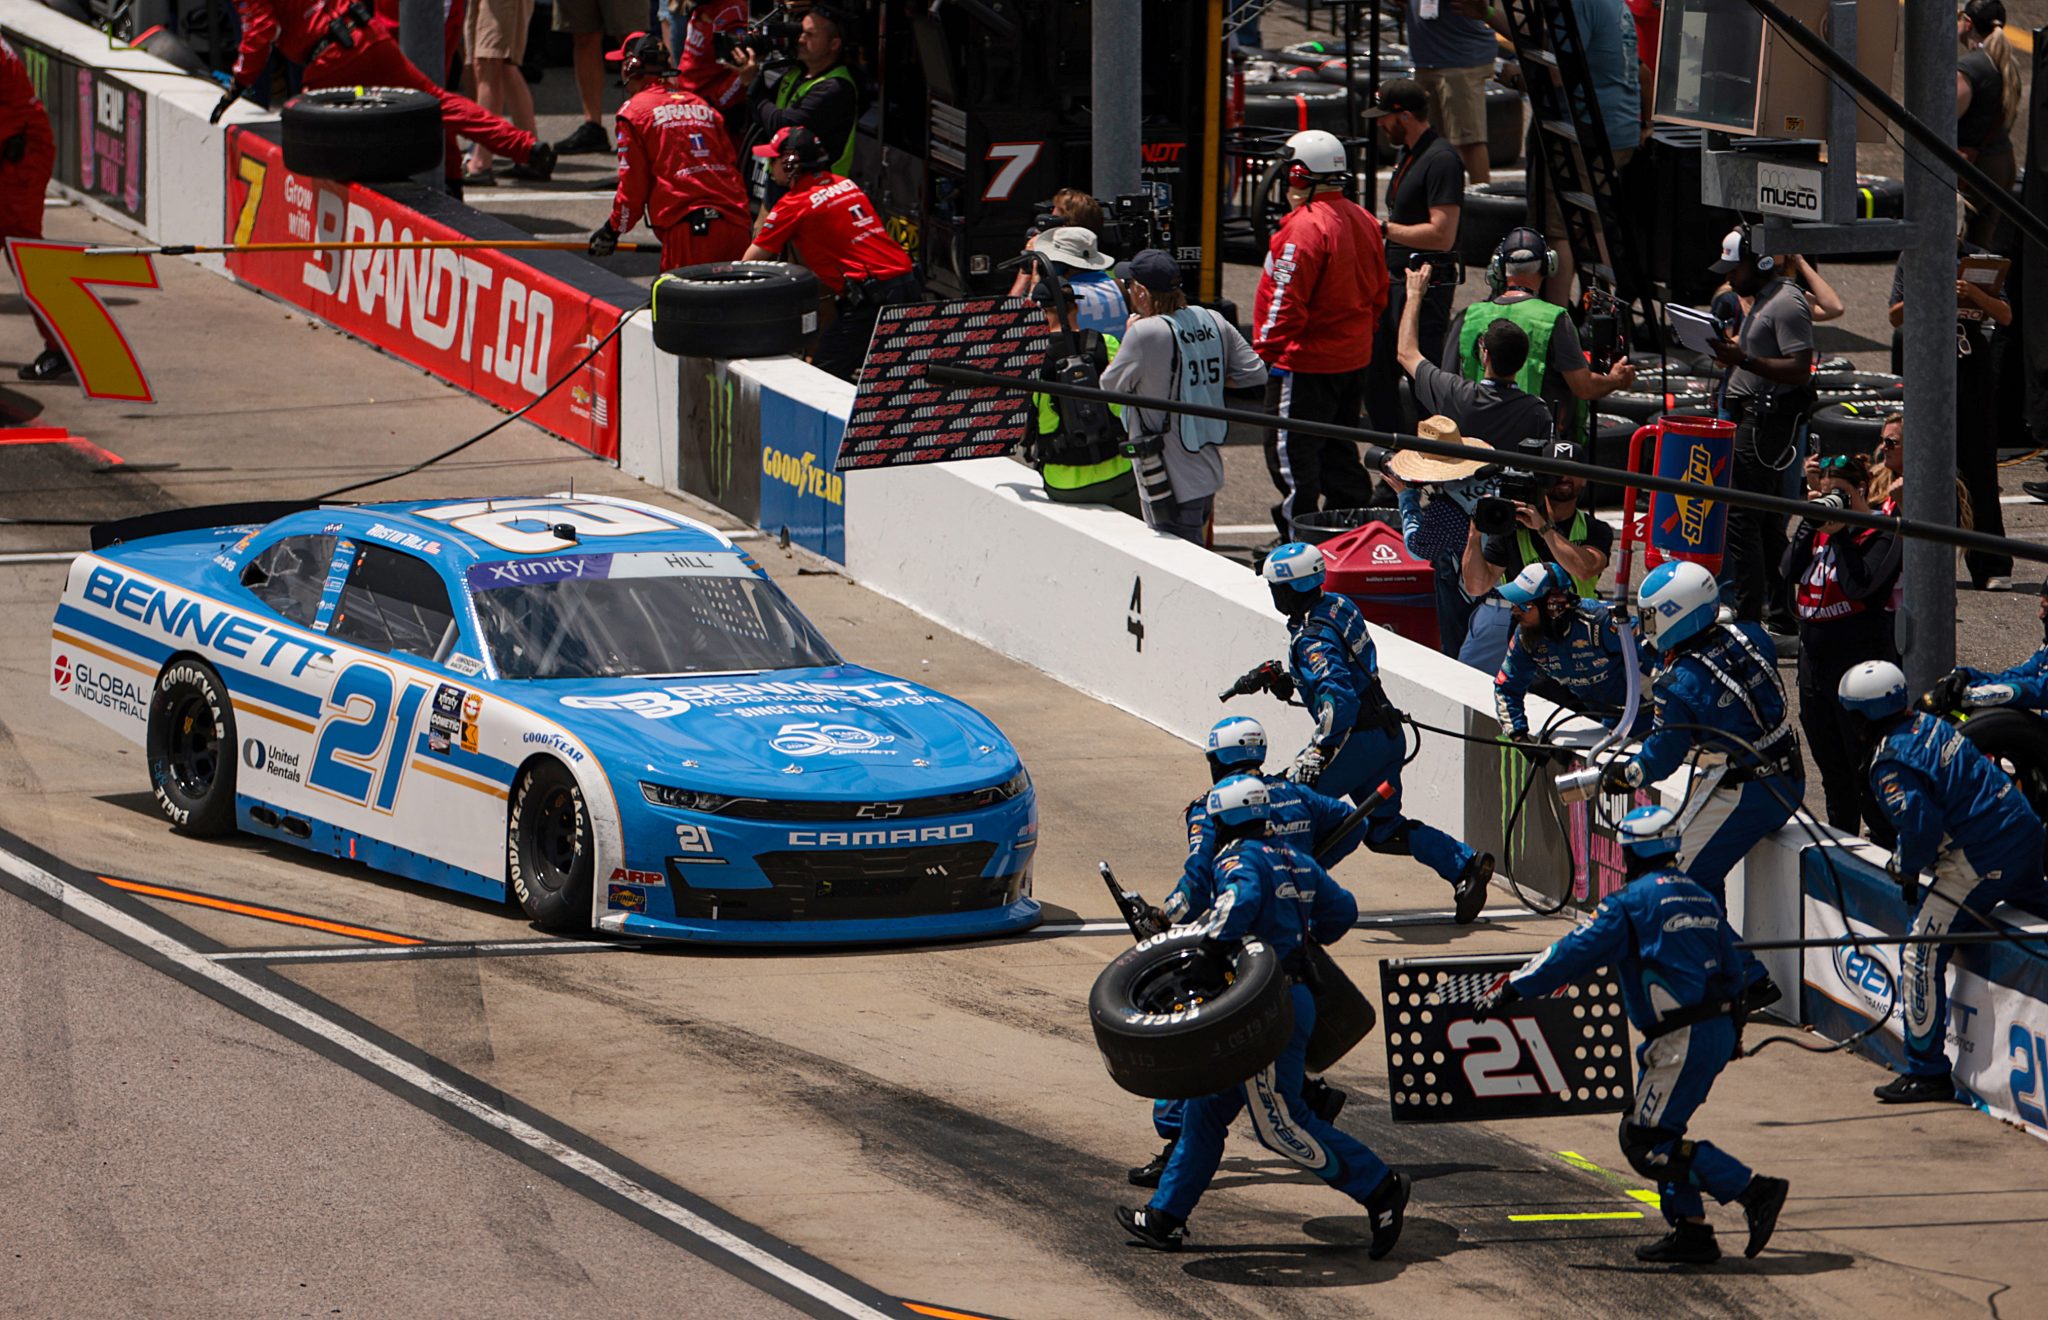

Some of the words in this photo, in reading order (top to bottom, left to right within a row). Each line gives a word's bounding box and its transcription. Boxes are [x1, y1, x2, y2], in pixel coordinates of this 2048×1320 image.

[982, 141, 1044, 201] 7
[236, 152, 267, 247] 7
[284, 174, 313, 211] Grow
[1761, 187, 1817, 210] MUSCO
[288, 211, 311, 241] with
[303, 188, 554, 398] BRANDT.CO
[905, 306, 936, 319] RCR
[963, 301, 995, 313] RCR
[928, 318, 959, 331] RCR
[986, 313, 1018, 326] RCR
[907, 334, 938, 347] RCR
[964, 329, 997, 342] RCR
[929, 347, 960, 358] RCR
[988, 342, 1020, 354] RCR
[870, 352, 902, 364] RCR
[872, 381, 904, 392] RCR
[969, 387, 1001, 398] RCR
[910, 392, 942, 404] RCR
[991, 399, 1024, 410] RCR
[873, 409, 905, 421] RCR
[932, 404, 965, 416] RCR
[910, 421, 944, 432] RCR
[970, 415, 1003, 427] RCR
[852, 425, 885, 437] RCR
[934, 432, 967, 444] RCR
[992, 428, 1024, 440] RCR
[875, 438, 908, 450] RCR
[972, 444, 1004, 456] RCR
[854, 454, 887, 466] RCR
[913, 449, 945, 461] RCR
[763, 446, 843, 506] GOODYEAR
[1682, 446, 1710, 542] SUNCO
[664, 553, 714, 569] HILL
[489, 557, 585, 582] xfinity
[1273, 562, 1294, 578] 21
[1658, 599, 1684, 618] 21
[83, 566, 337, 677] BENNETT
[75, 663, 147, 706] GLOBAL
[664, 681, 917, 702] BENNETT
[74, 683, 147, 722] INDUSTRIAL
[161, 666, 226, 740] GOODYEAR
[734, 704, 793, 718] SINCE
[790, 704, 838, 715] 1974
[431, 713, 460, 732] COMETIC
[305, 659, 434, 817] 21
[523, 732, 584, 763] GOODYEAR
[268, 745, 300, 767] United
[266, 760, 301, 783] Rentals
[154, 786, 190, 825] EAGLE
[676, 824, 714, 853] 21
[788, 823, 974, 846] CAMARO
[609, 867, 663, 884] ARP
[611, 892, 645, 906] SUNOCO
[1447, 1017, 1572, 1098] 21
